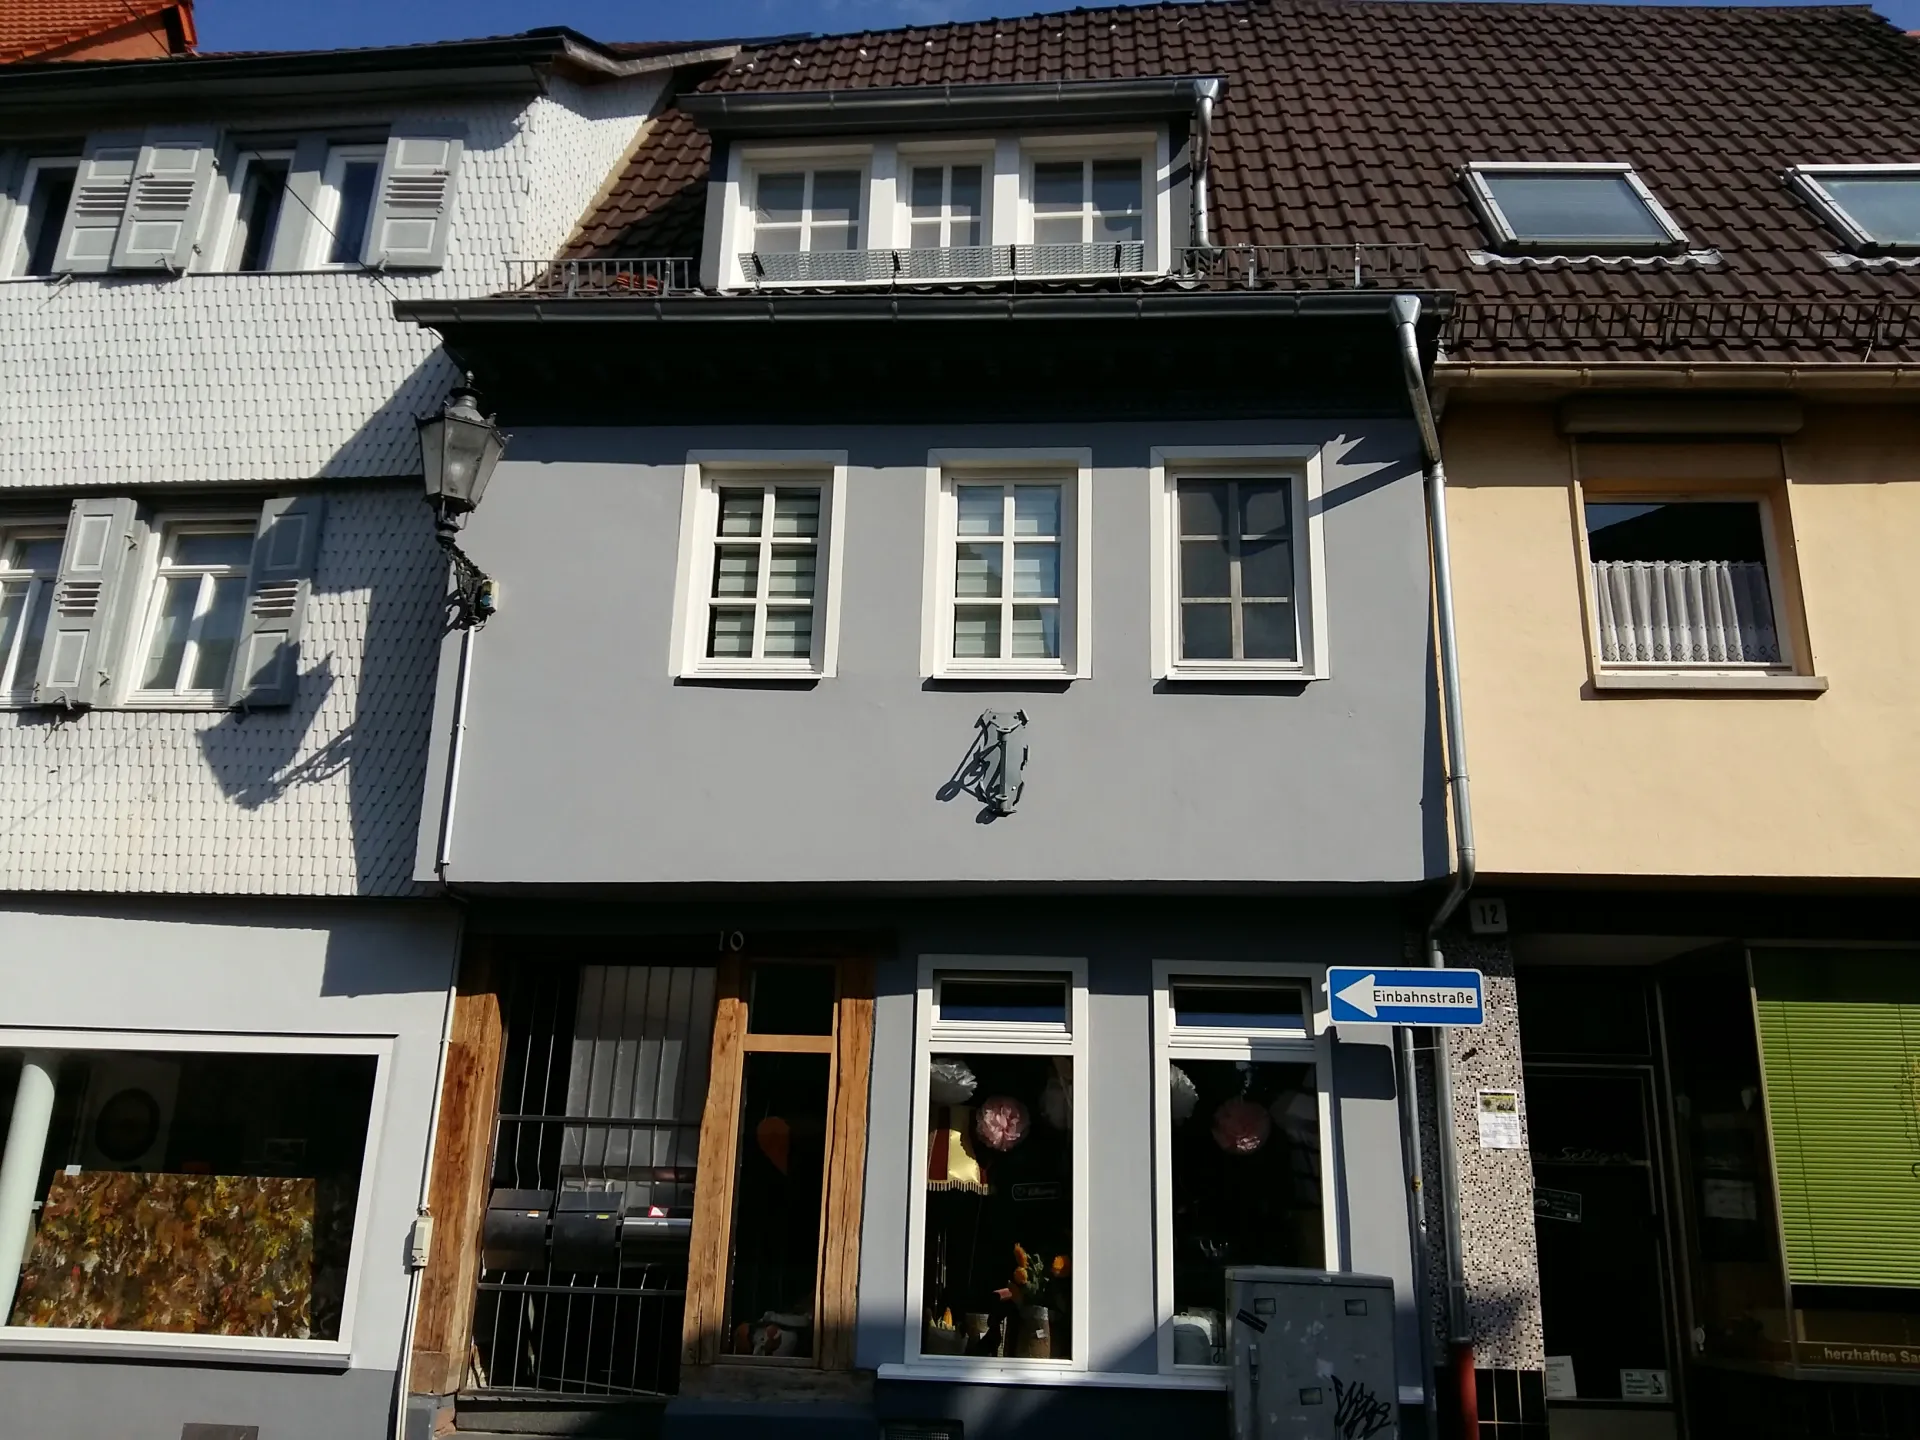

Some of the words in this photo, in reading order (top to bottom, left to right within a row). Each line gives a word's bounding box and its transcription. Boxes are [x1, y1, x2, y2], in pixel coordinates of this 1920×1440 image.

[1480, 904, 1499, 925] 12
[718, 930, 744, 952] 10
[1373, 990, 1473, 1004] Einbahnstraße
[1824, 1347, 1897, 1363] herzhaftes
[1899, 1350, 1920, 1364] Sa
